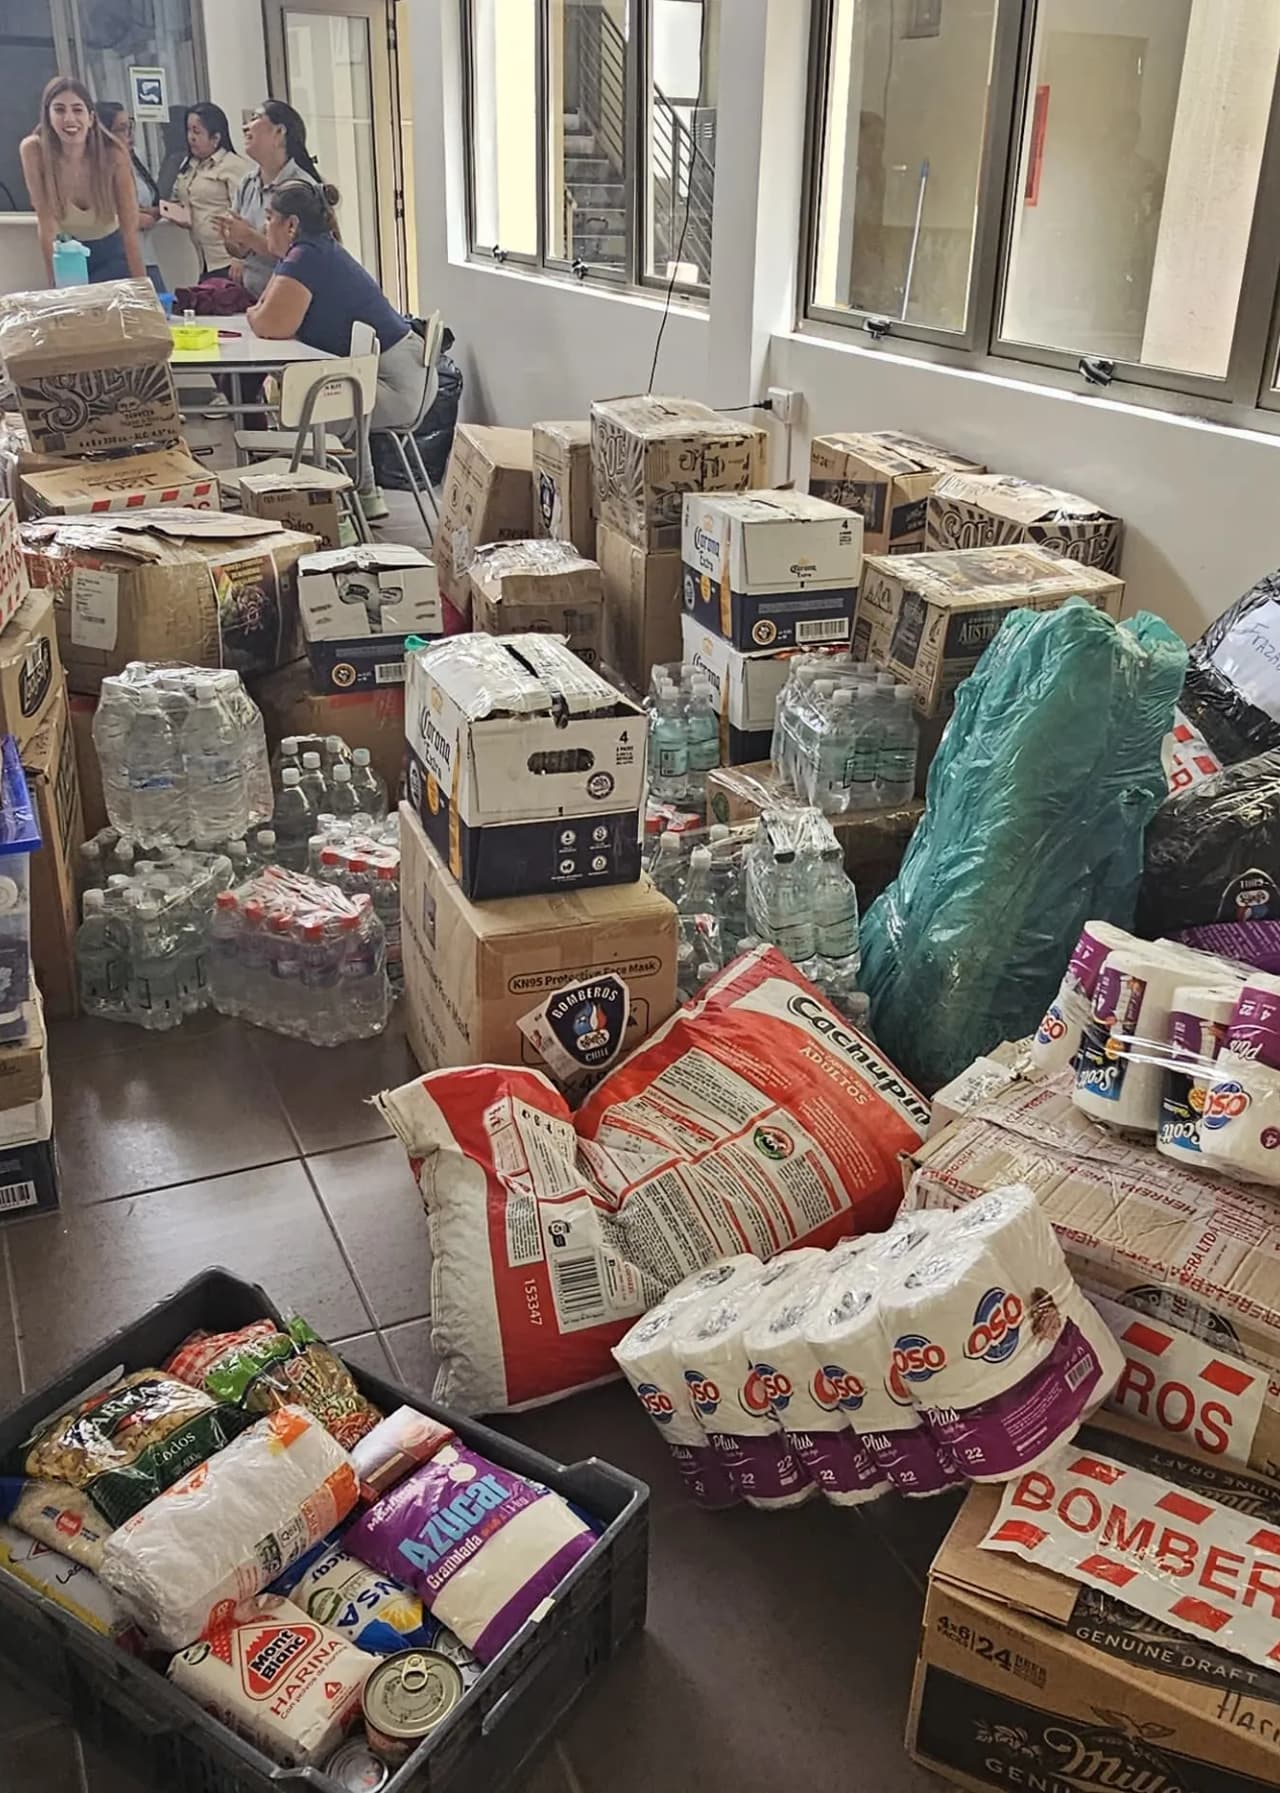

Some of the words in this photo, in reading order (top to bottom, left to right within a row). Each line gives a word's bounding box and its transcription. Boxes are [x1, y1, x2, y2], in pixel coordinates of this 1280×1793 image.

[694, 526, 721, 557] Corona
[790, 564, 817, 574] Corona
[420, 704, 451, 767] Corona
[618, 731, 628, 743] 4
[512, 978, 543, 991] KN95
[628, 961, 657, 974] Mask
[551, 986, 619, 1019] BOMBEROS
[799, 1046, 869, 1106] ADULTOS
[1076, 1063, 1119, 1093] Scott
[523, 1278, 543, 1326] 153347
[964, 1292, 1023, 1359] OSO
[927, 1404, 960, 1426] Plus
[151, 1430, 197, 1466] Codos
[713, 1433, 740, 1451] Plus
[861, 1434, 891, 1453] Plus
[965, 1446, 984, 1460] 22
[740, 1470, 755, 1485] 22
[901, 1470, 916, 1484] 22
[398, 1472, 513, 1573] Azúcar
[307, 1551, 352, 1582] úcar
[337, 1577, 408, 1629] NSA
[251, 1626, 295, 1673] Mont
[262, 1635, 307, 1681] Blanc
[976, 1635, 1013, 1672] 24
[1075, 1626, 1175, 1664] GENUINE
[1181, 1656, 1262, 1687] DRAFT
[269, 1638, 345, 1717] HARINA
